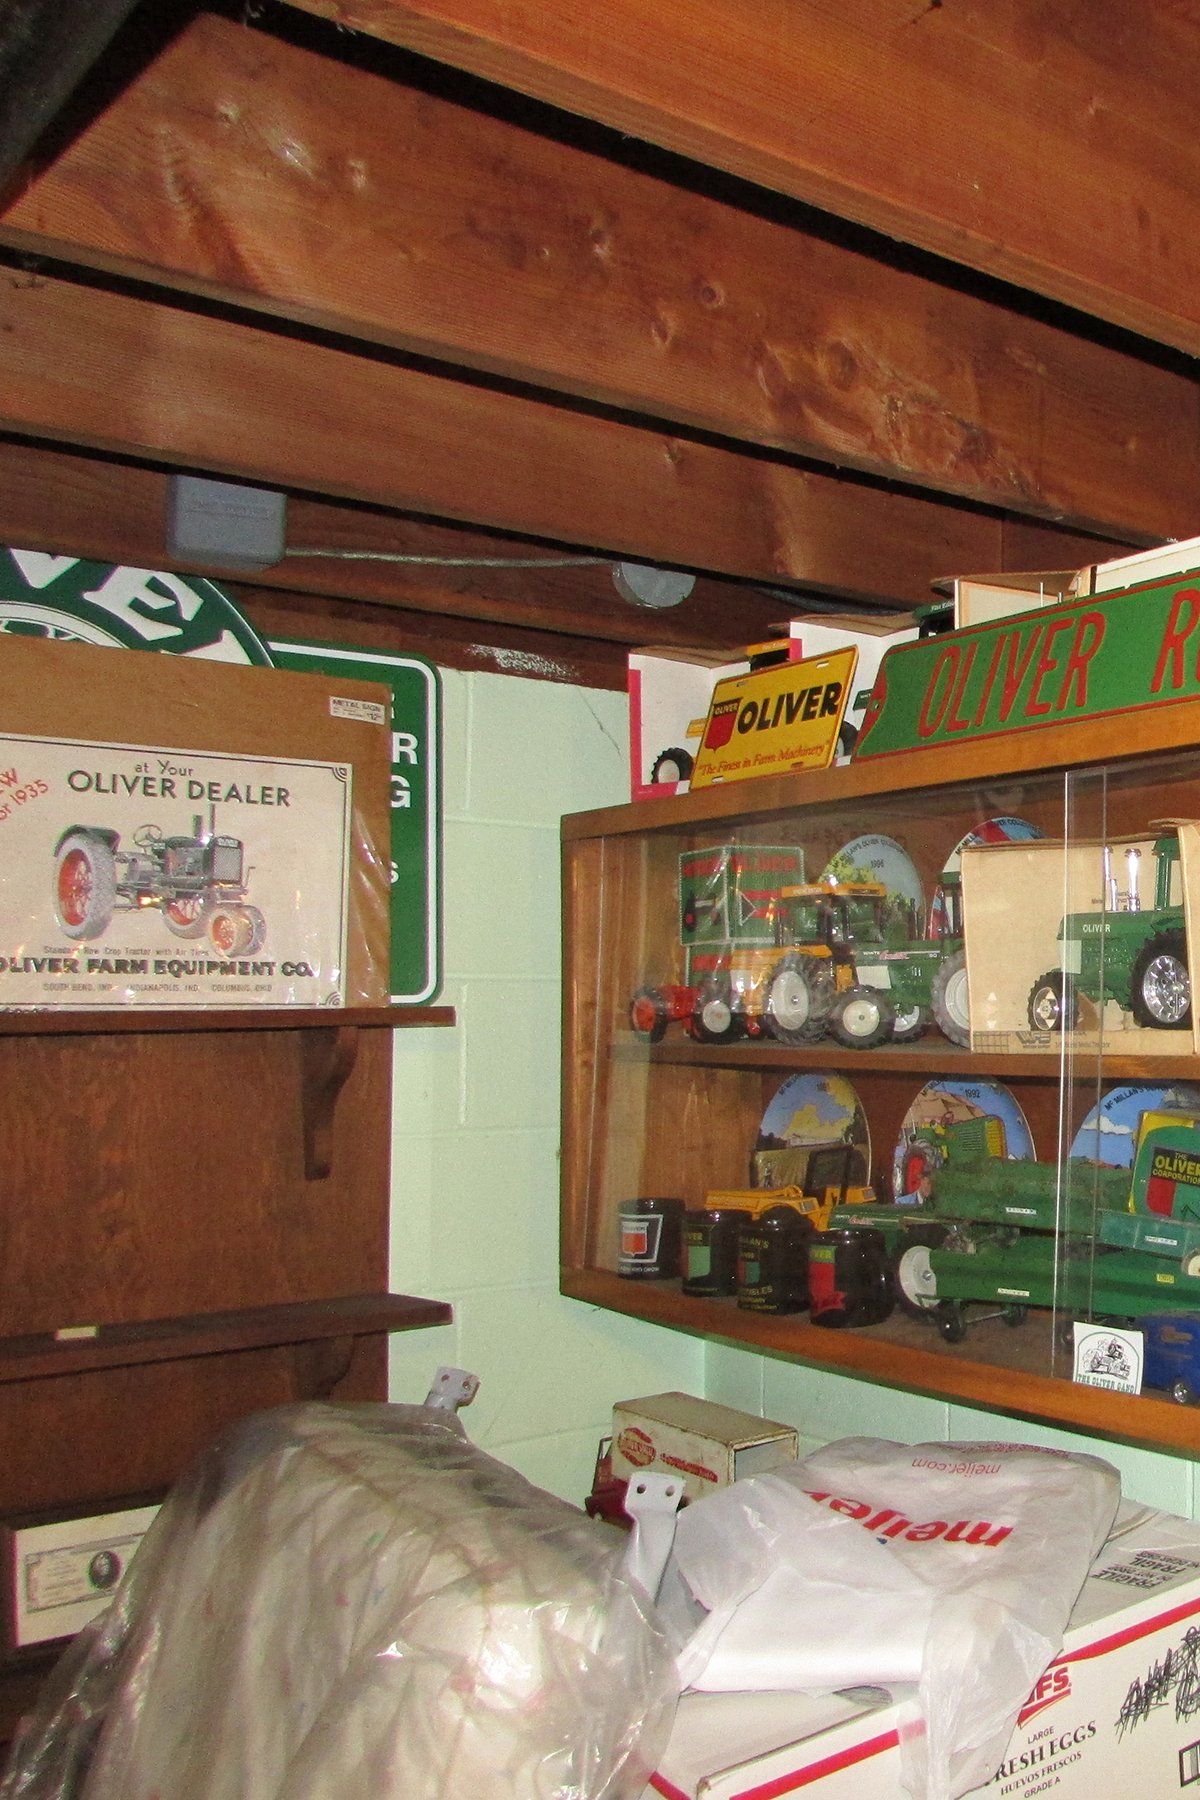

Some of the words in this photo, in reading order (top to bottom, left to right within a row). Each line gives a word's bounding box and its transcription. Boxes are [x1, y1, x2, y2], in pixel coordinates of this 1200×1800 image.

[917, 611, 1107, 738] OLIVER
[715, 702, 739, 716] OLIVER
[737, 681, 843, 735] OLIVER
[135, 761, 149, 774] at
[157, 759, 194, 777] Your
[719, 757, 741, 772] Finest
[742, 757, 751, 767] in
[754, 753, 777, 766] Farm
[10, 779, 49, 806] 1935
[68, 769, 177, 799] OLIVER
[188, 780, 291, 808] DEALER
[105, 947, 121, 956] Crop
[125, 947, 151, 956] Tractor
[87, 957, 149, 975] FARM
[154, 959, 277, 978] EQUIPMENT
[44, 982, 71, 992] SOUTH
[1114, 1087, 1145, 1105] MILLAN'S
[1175, 1152, 1188, 1161] THE
[1078, 1373, 1090, 1384] THE
[1092, 1375, 1116, 1390] OLIVER
[911, 1457, 1002, 1476] meijer.com
[1028, 1726, 1055, 1744] LARGE
[989, 1745, 1046, 1785] RESH
[1049, 1720, 1097, 1757] EGGS
[1001, 1773, 1040, 1796] HUEVOS
[1041, 1751, 1082, 1777] FRESCOS
[1024, 1780, 1054, 1799] GRADE
[1054, 1776, 1061, 1784] A
